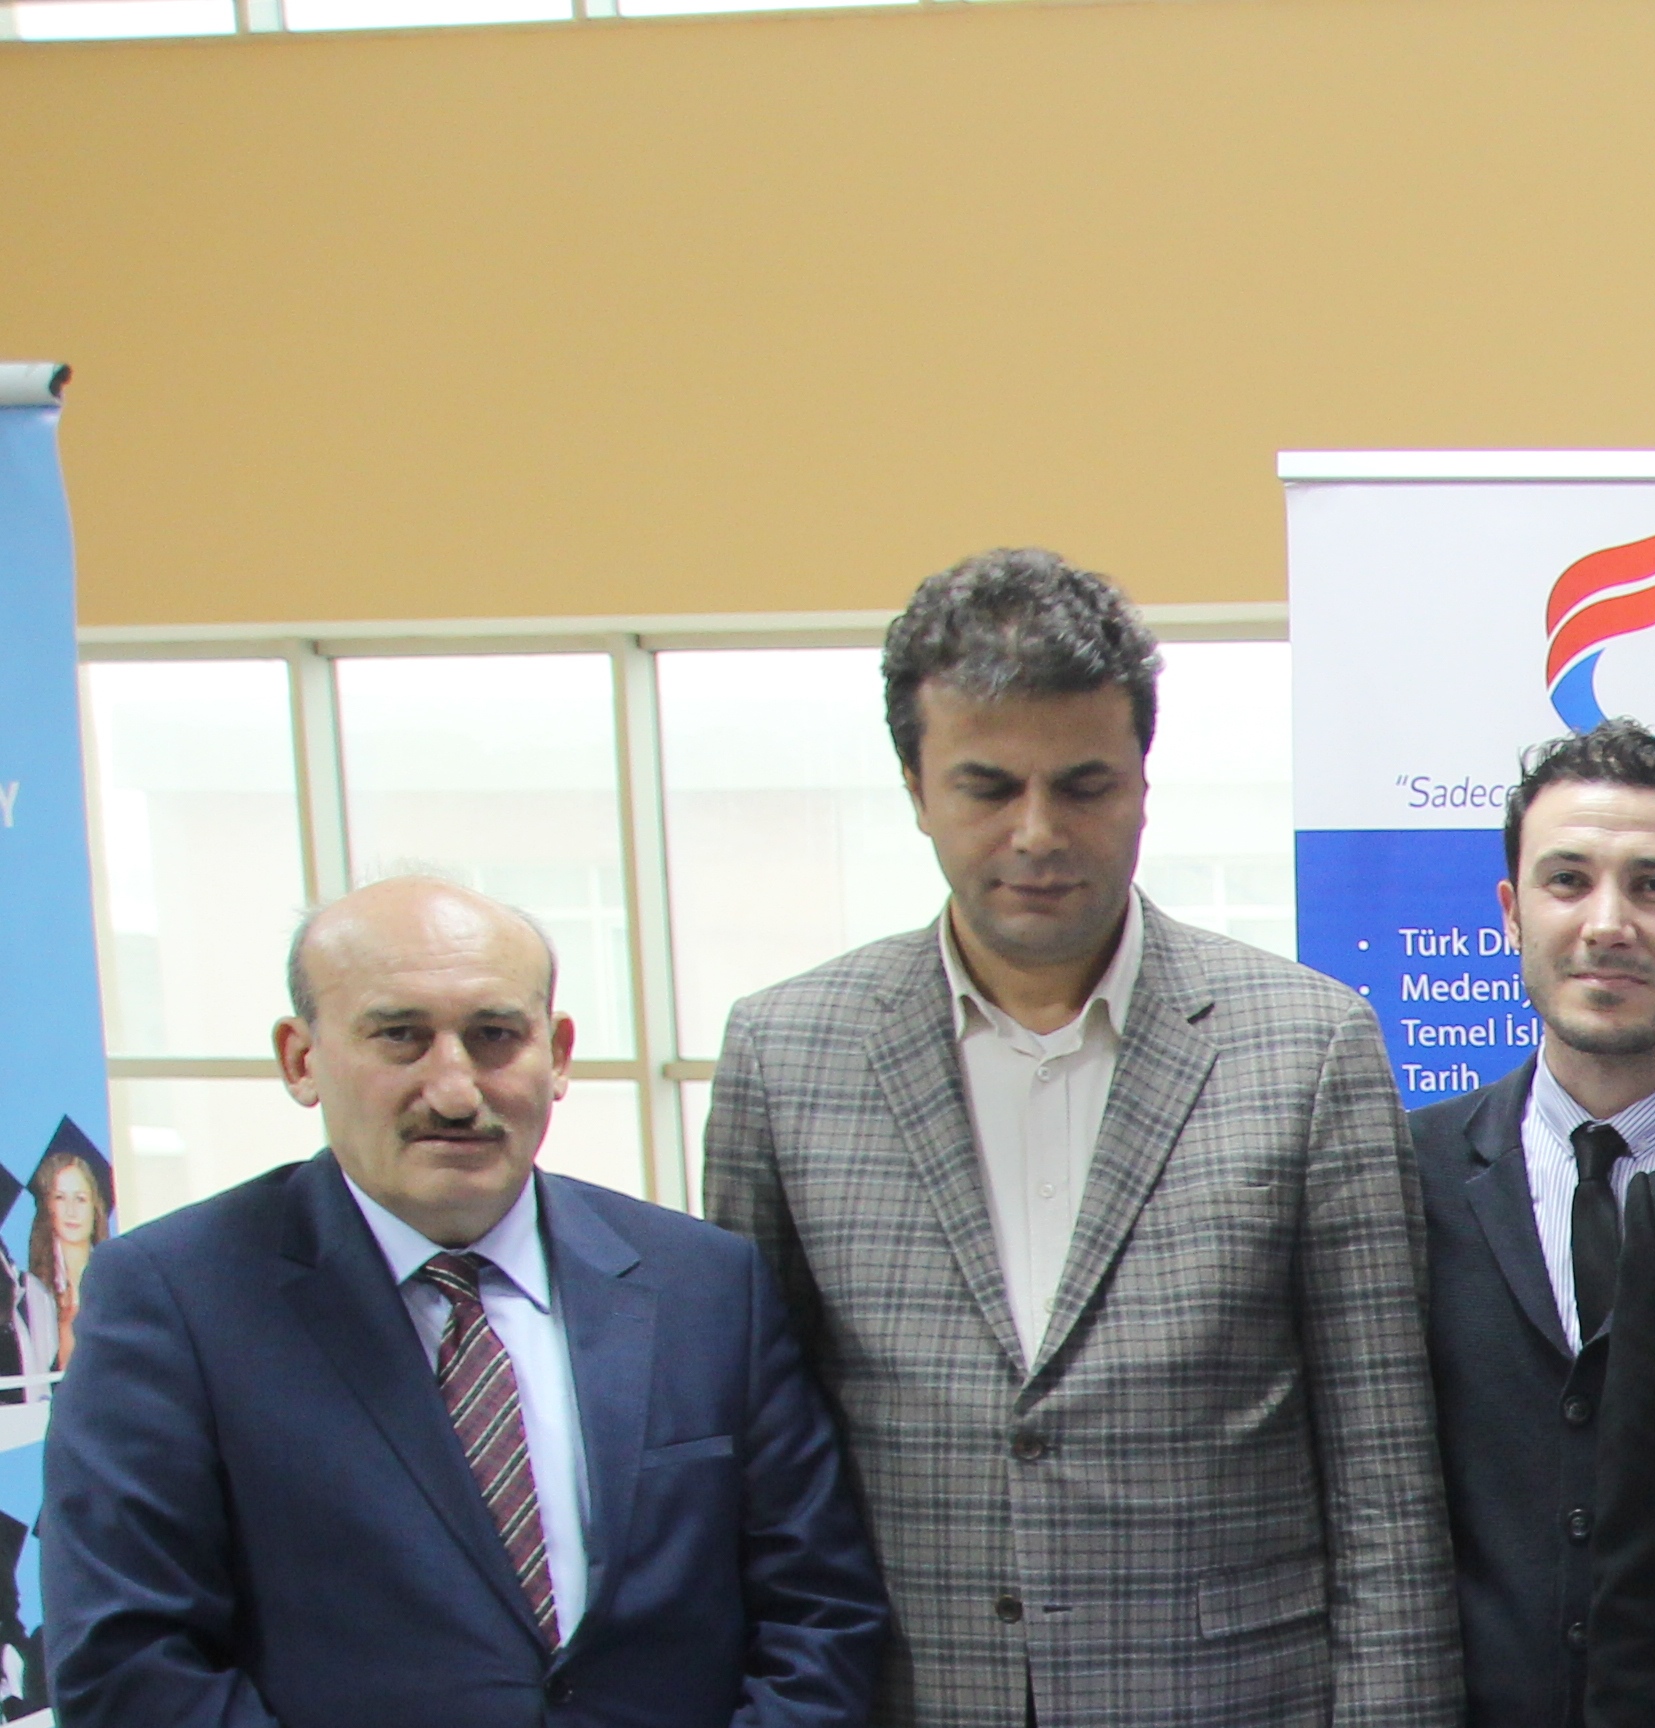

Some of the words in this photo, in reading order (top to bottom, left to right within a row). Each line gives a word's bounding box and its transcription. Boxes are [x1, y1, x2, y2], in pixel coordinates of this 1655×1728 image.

[1398, 927, 1470, 957] Türk
[1400, 1017, 1496, 1048] Temel
[1401, 1062, 1480, 1092] Tarih
